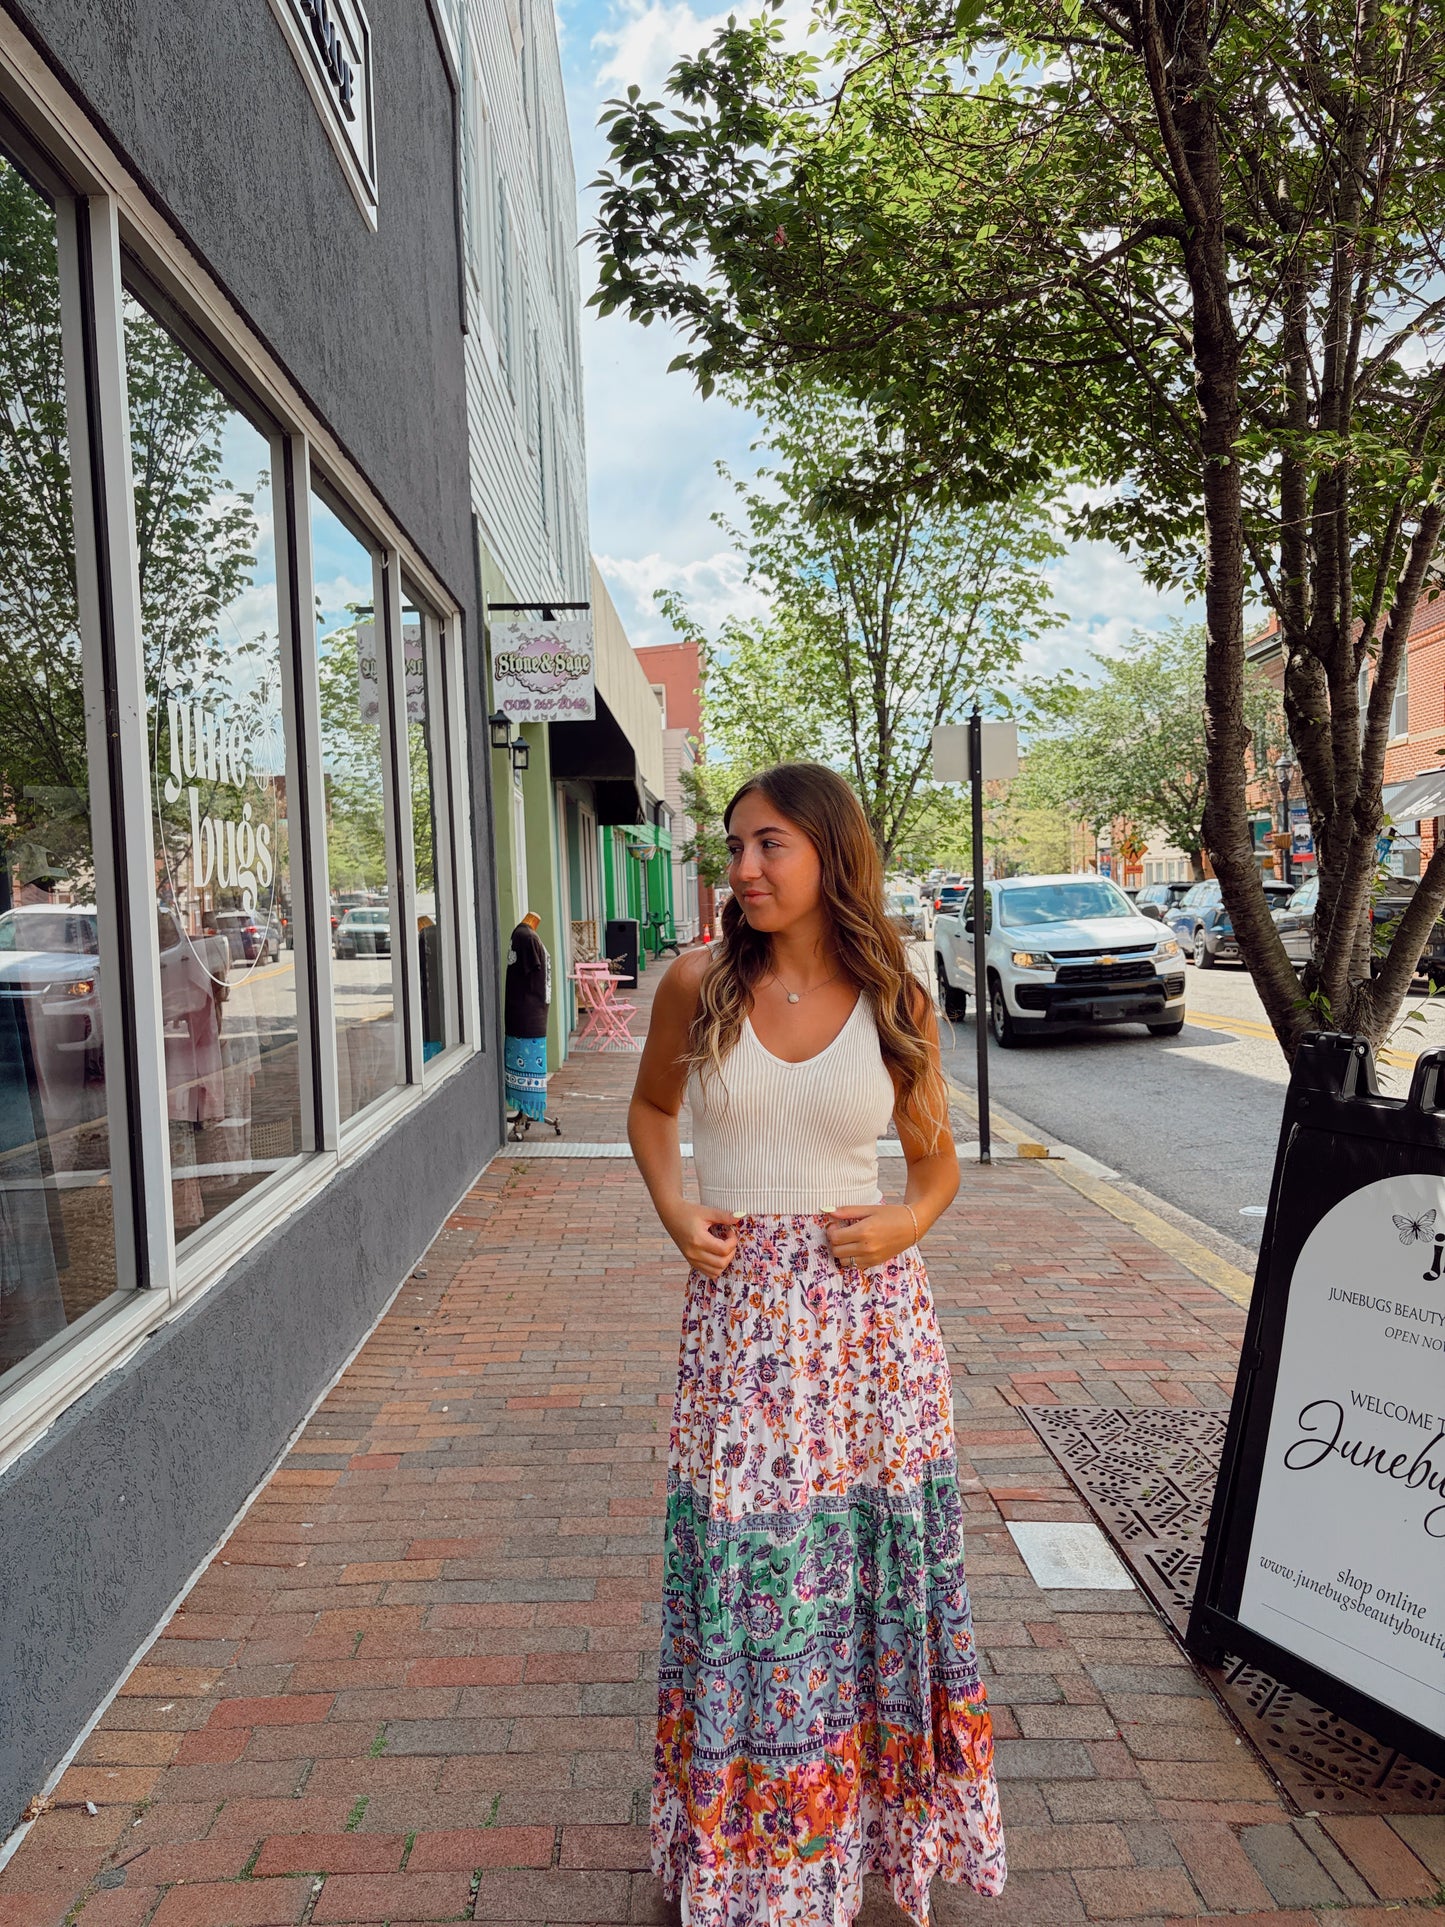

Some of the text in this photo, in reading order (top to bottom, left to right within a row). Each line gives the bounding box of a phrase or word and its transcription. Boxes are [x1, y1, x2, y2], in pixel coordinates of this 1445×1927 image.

[496, 652, 590, 679] Stone & Sage
[188, 786, 273, 914] bugs
[1328, 1287, 1445, 1327] JUNEBUGS BEAUTY
[1384, 1326, 1445, 1352] OPEN NO
[1350, 1389, 1433, 1431] WELCOME
[1336, 1568, 1427, 1620] shop online
